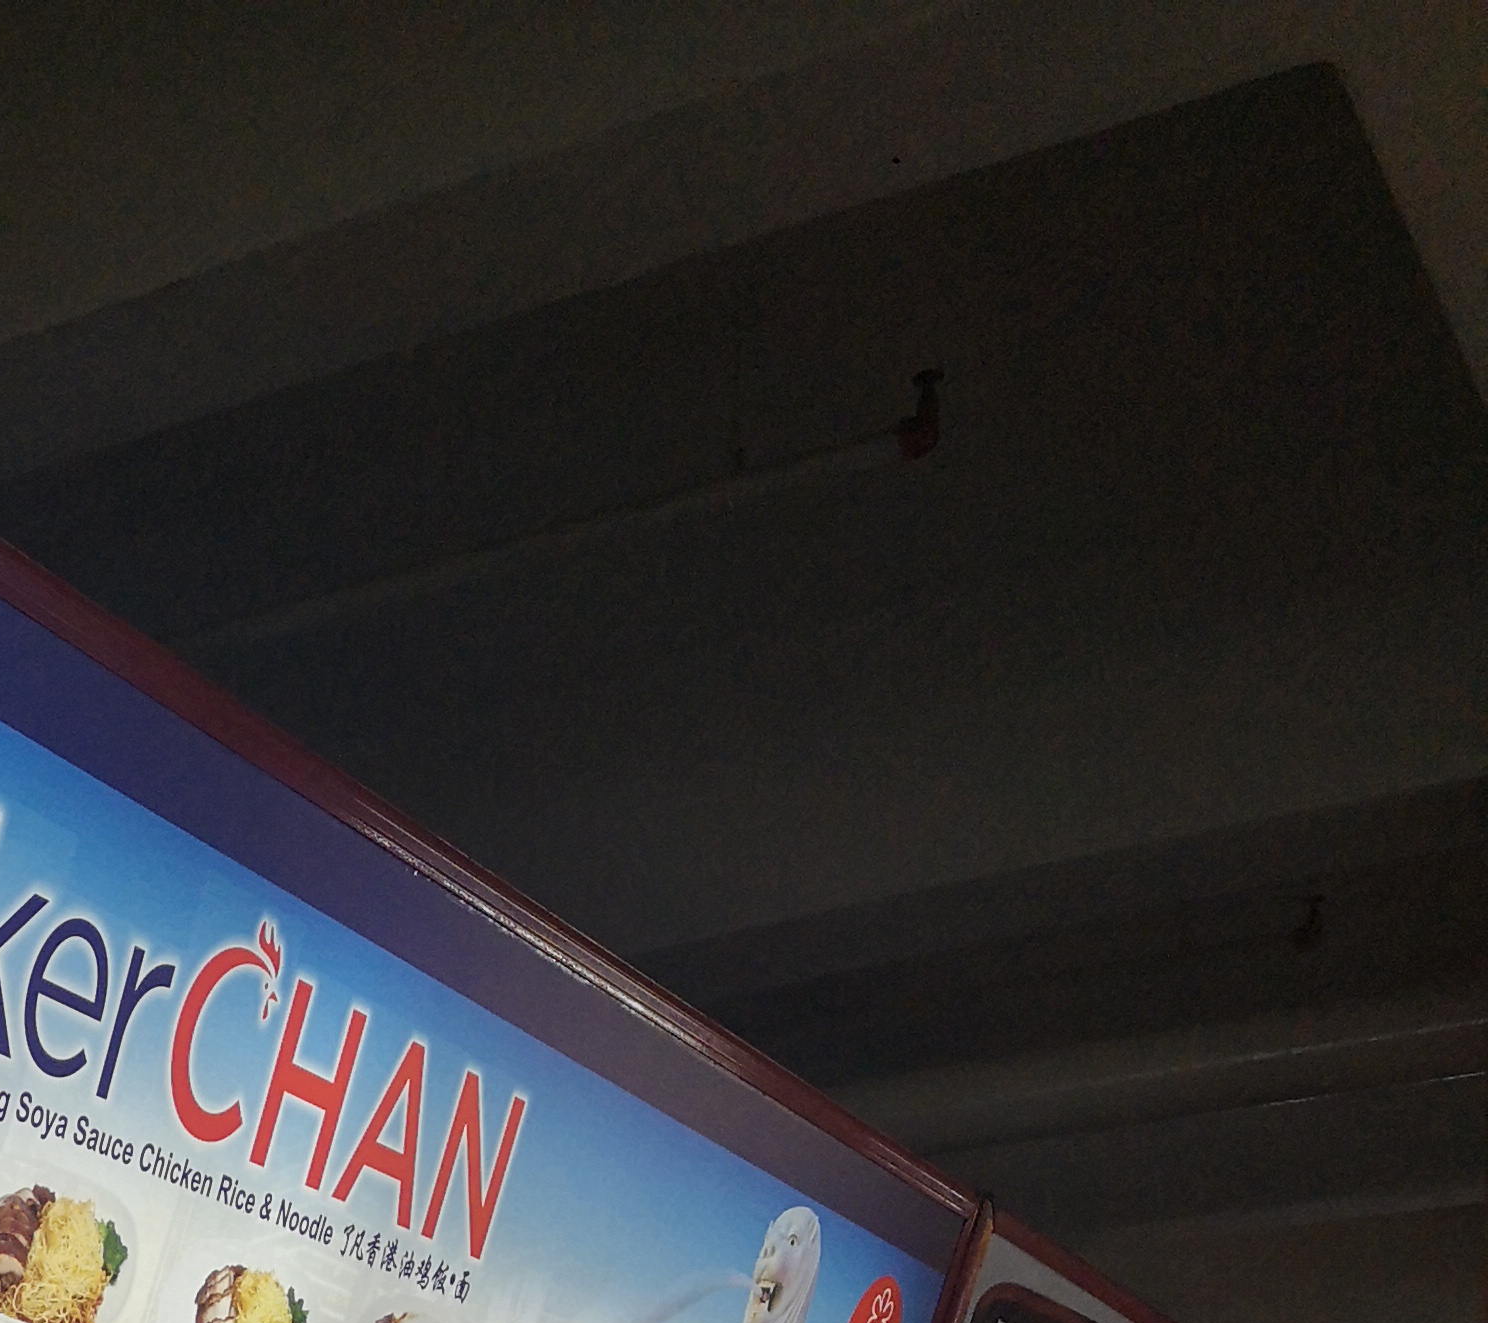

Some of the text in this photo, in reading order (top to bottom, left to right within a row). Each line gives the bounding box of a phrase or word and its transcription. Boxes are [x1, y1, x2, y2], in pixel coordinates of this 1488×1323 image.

[15, 1091, 67, 1140] Soya
[73, 1116, 133, 1165] Sauce
[139, 1144, 214, 1197] Chicken
[217, 1174, 255, 1215] Rice
[259, 1192, 272, 1220] &
[275, 1200, 334, 1246] Noodle
